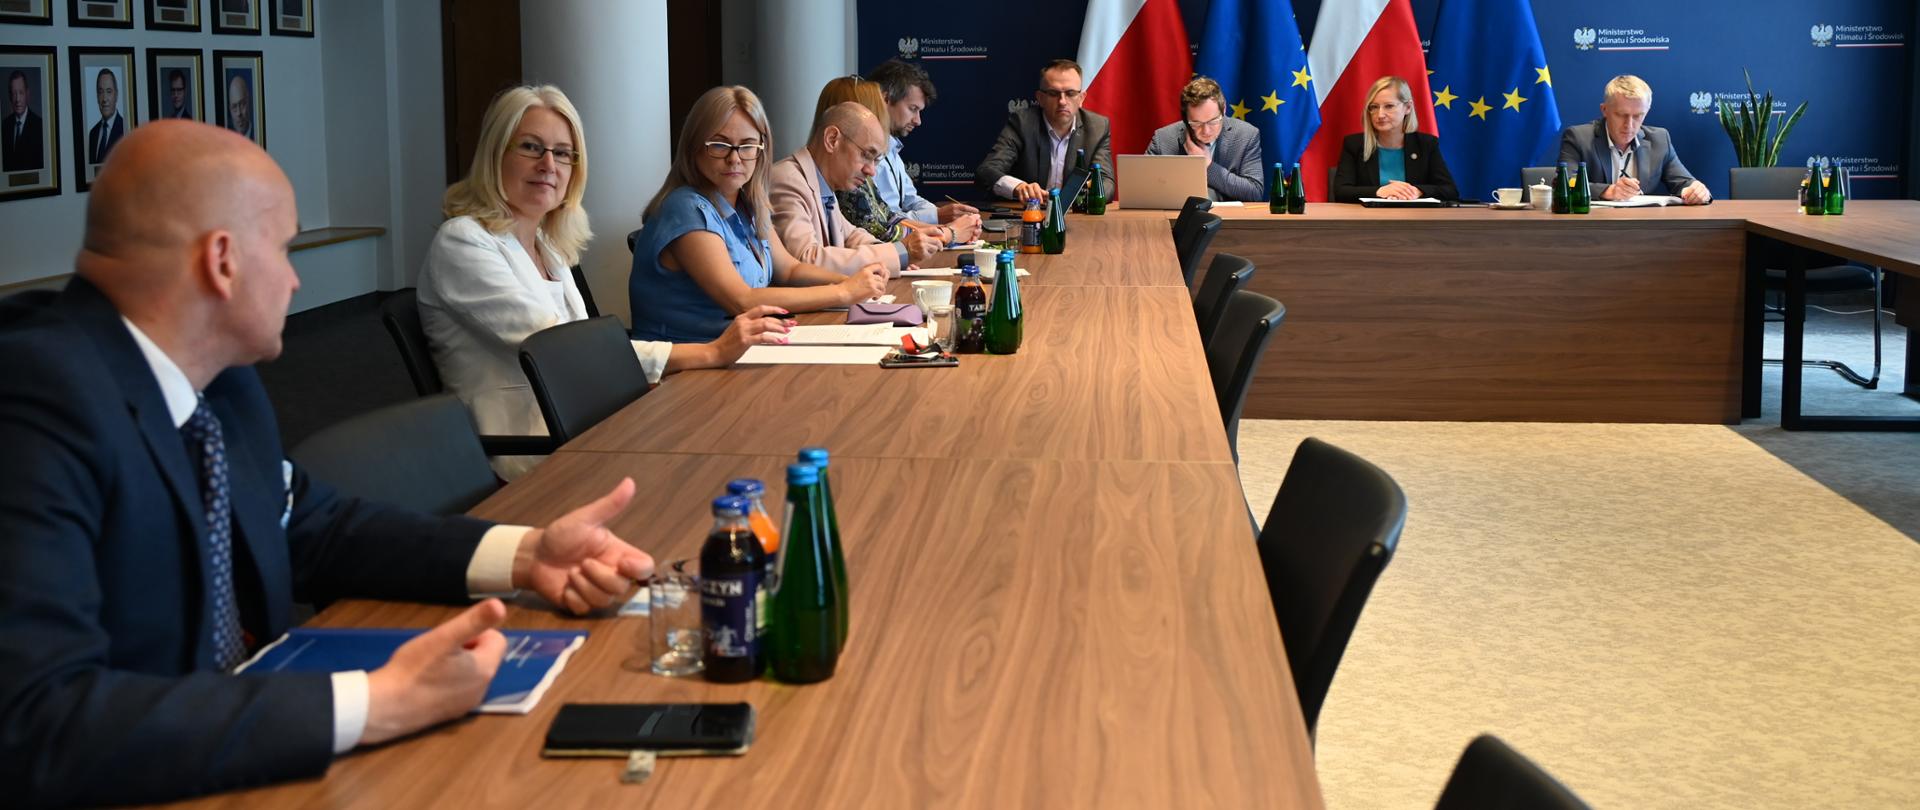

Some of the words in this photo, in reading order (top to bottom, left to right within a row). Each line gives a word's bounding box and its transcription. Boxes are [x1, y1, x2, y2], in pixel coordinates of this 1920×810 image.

[1598, 28, 1644, 36] Ministerstwo
[1629, 36, 1670, 44] Środowiska
[1835, 33, 1863, 41] Klimatu
[950, 45, 987, 53] Środowiska
